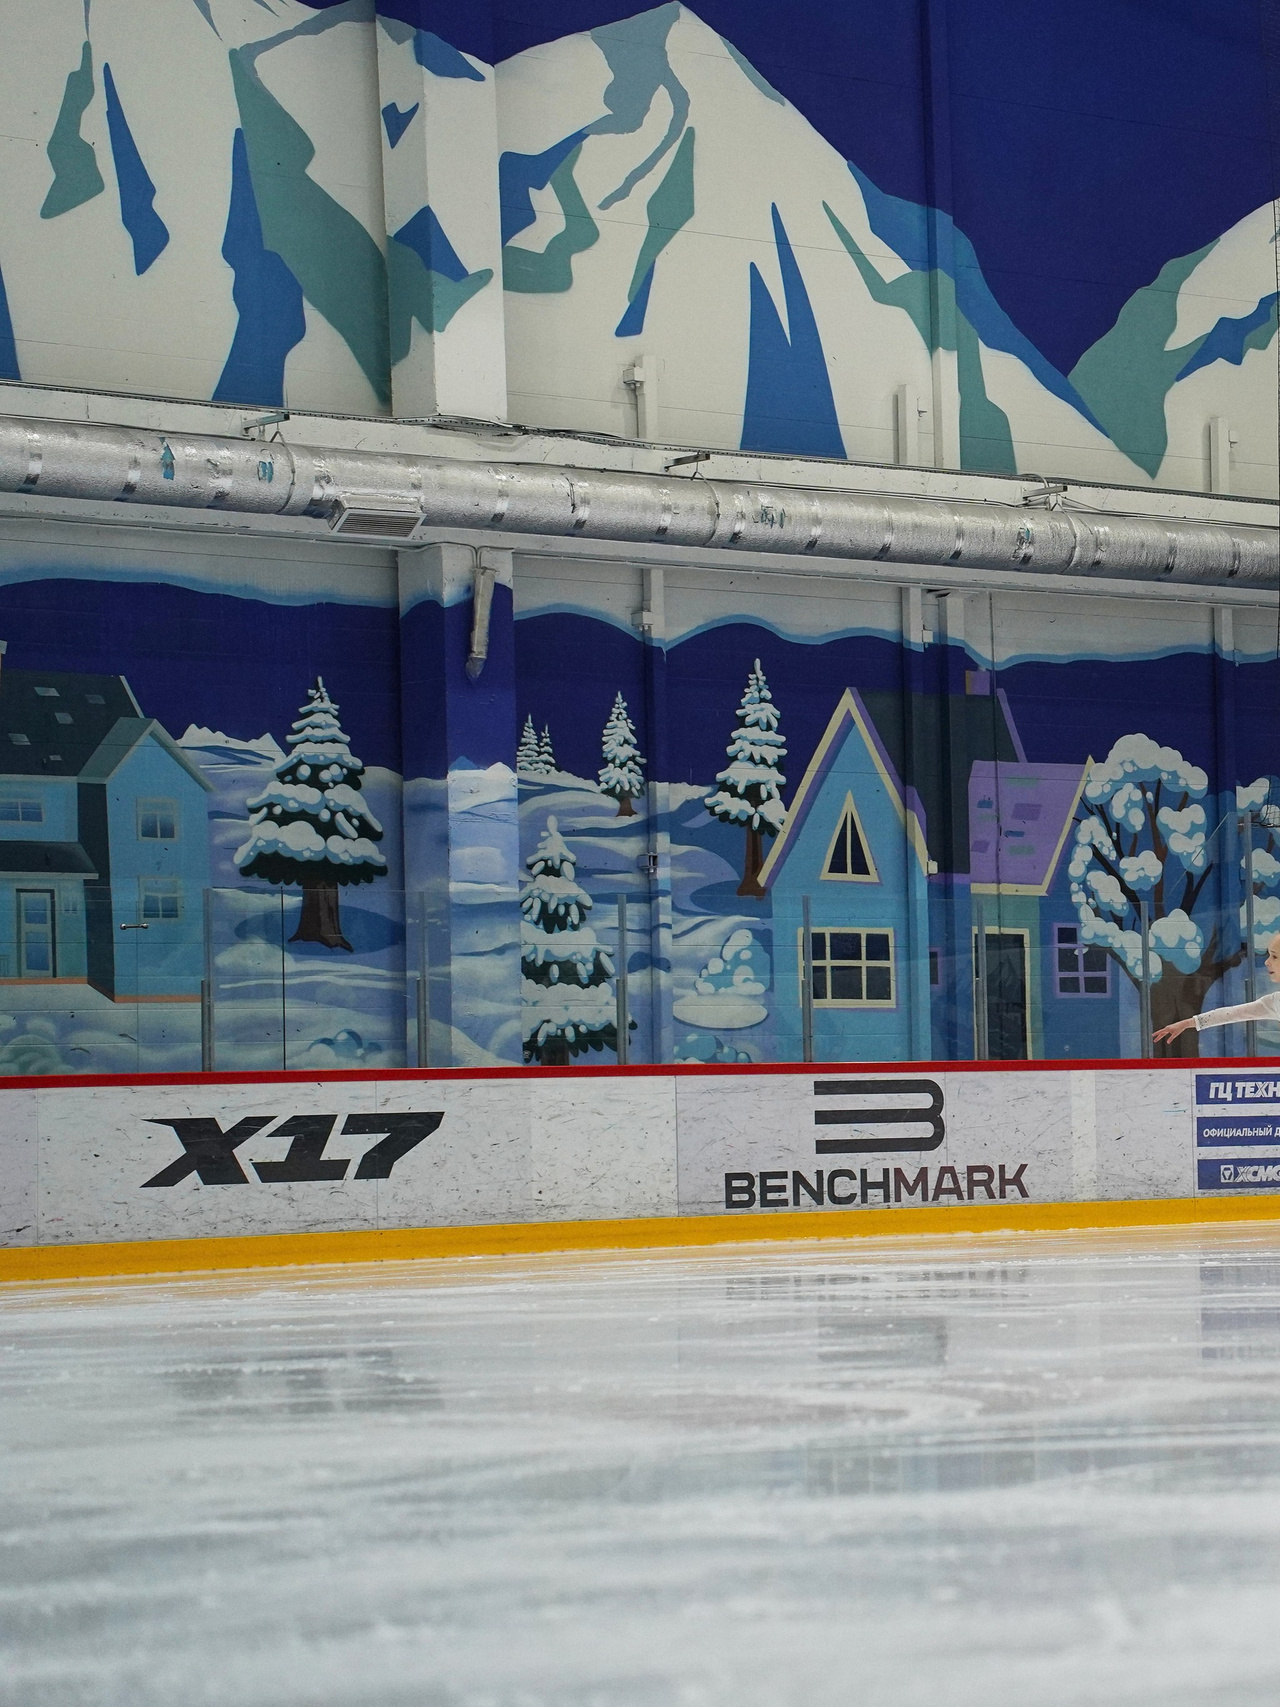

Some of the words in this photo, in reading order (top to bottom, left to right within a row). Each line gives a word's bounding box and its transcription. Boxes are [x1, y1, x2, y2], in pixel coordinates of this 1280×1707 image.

[1209, 1082, 1233, 1101] ГЦ
[1203, 1124, 1273, 1138] ОФИЦИАЛЬНЫЙ
[140, 1111, 445, 1188] X17
[724, 1163, 1029, 1209] BENCHMARK
